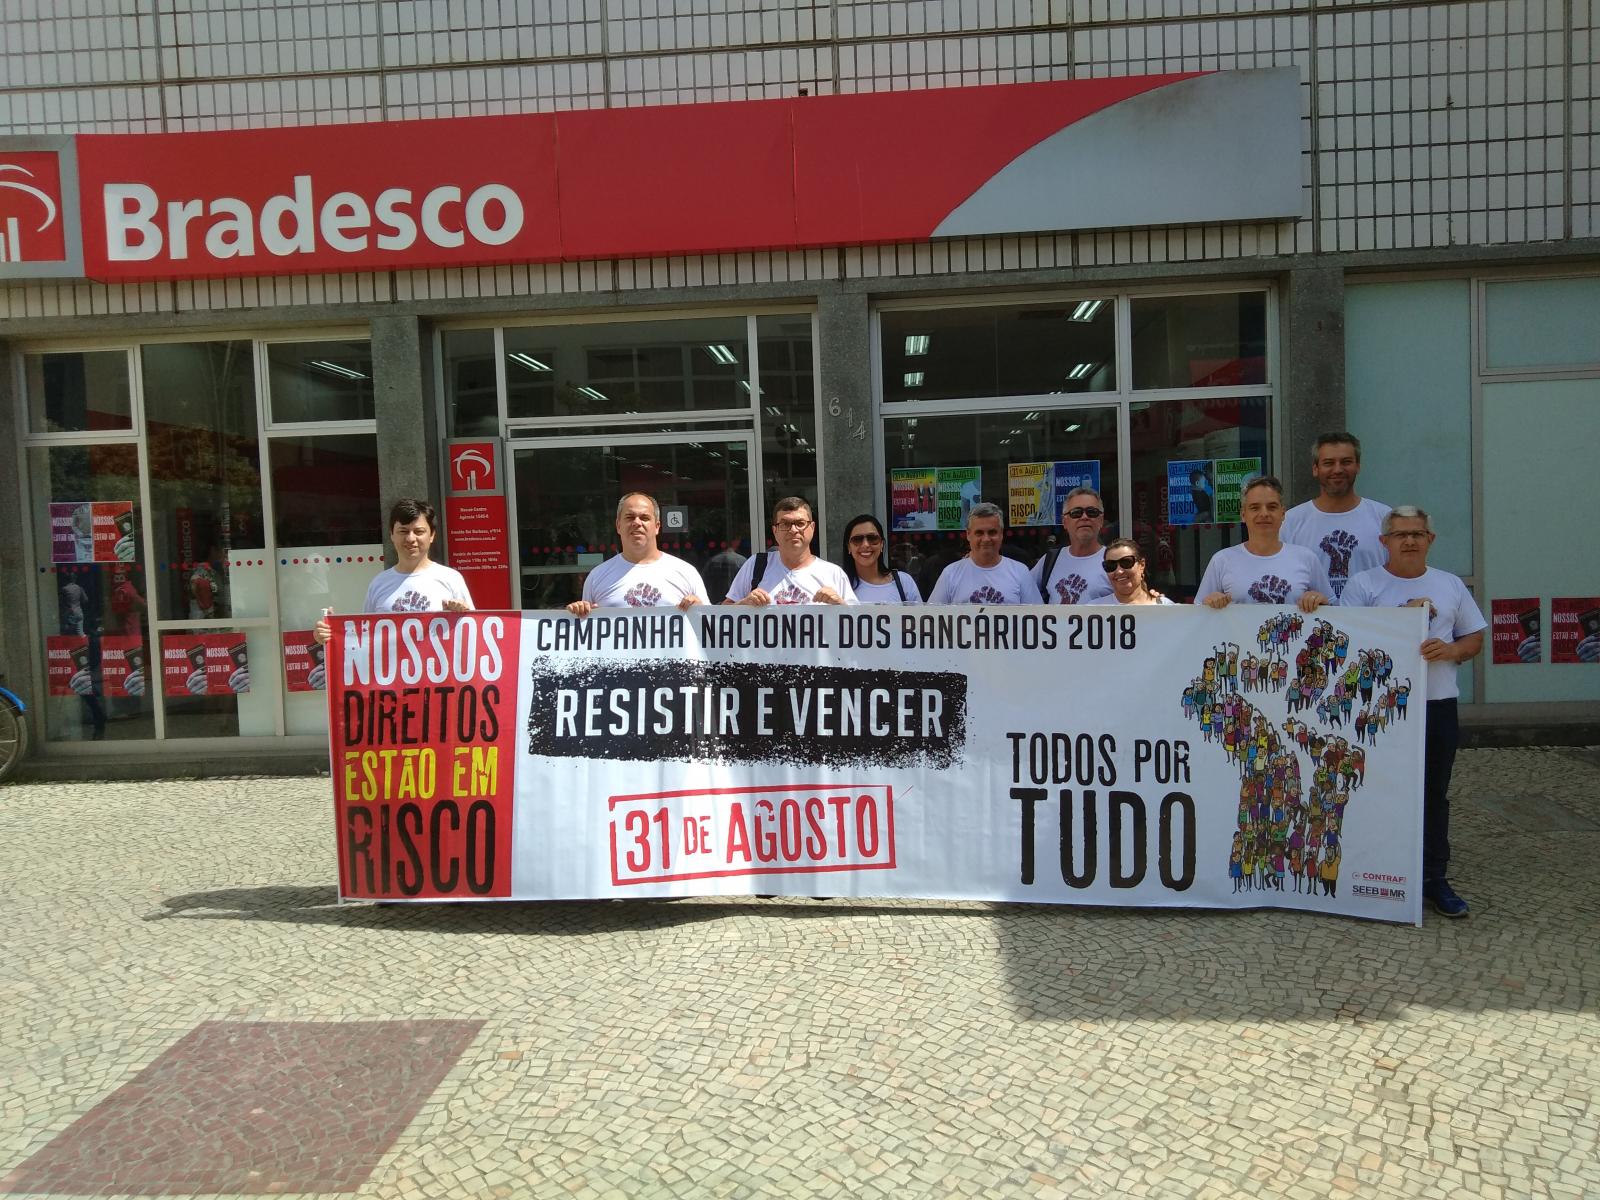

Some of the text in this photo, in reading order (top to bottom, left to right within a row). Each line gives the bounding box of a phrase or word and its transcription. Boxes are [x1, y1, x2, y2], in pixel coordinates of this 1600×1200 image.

[103, 174, 524, 261] Bradesco
[1056, 477, 1080, 487] NOSSOS
[1217, 474, 1242, 484] NOSSOS
[938, 482, 962, 492] NOSSOS
[938, 507, 962, 520] RISCO
[1011, 504, 1036, 517] RISCO
[93, 515, 115, 525] NOSSOS
[1493, 613, 1519, 624] NOSSOS
[1553, 612, 1579, 623] NOSSOS
[537, 607, 1137, 651] CAMPANHA NACIONAL DOS BANCÁRIOS 2018
[49, 649, 71, 659] NOSSOS
[102, 649, 125, 660] NOSSOS
[164, 649, 187, 659] NOSSOS
[206, 647, 229, 658] NOSSOS
[285, 644, 308, 655] NOSSOS
[344, 616, 504, 686] NOSSOS
[344, 684, 501, 747] DIREITOS
[555, 686, 945, 738] RESISTIR E VENCER
[1006, 732, 1192, 787] TODOS POR
[345, 746, 498, 802] ESTÃO EM
[625, 794, 880, 873] 31 DE AGOSTO
[1009, 787, 1197, 892] TUDO
[346, 799, 497, 897] RISCO
[1362, 872, 1403, 883] CONTRAF
[1352, 884, 1379, 895] SEEB
[1389, 888, 1406, 899] MR
